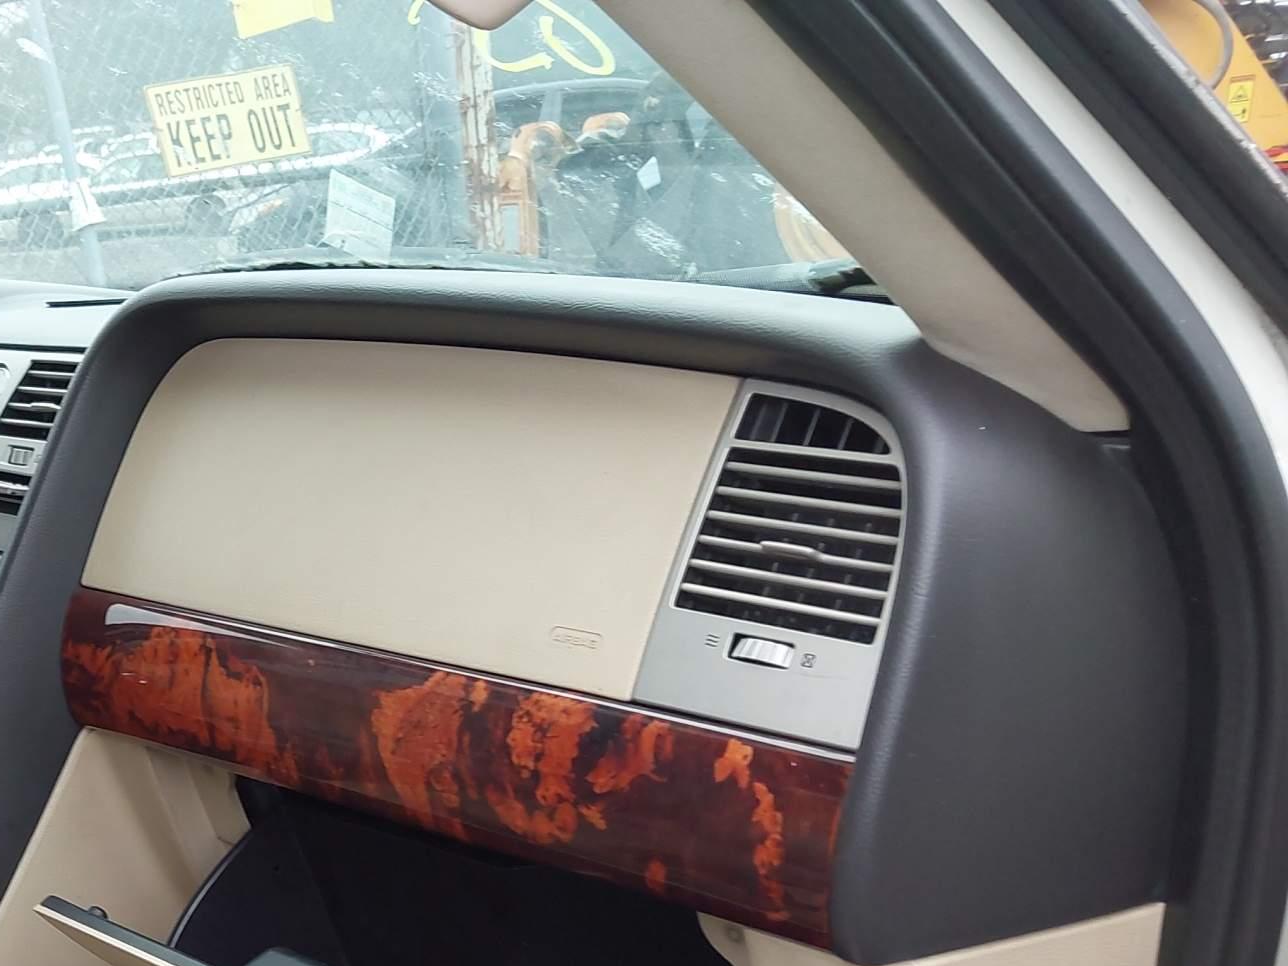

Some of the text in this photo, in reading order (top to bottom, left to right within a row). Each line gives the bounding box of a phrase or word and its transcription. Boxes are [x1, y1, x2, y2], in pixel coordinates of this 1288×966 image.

[155, 73, 292, 117] RESTRICTED AREA
[166, 103, 296, 168] KEEP OUT
